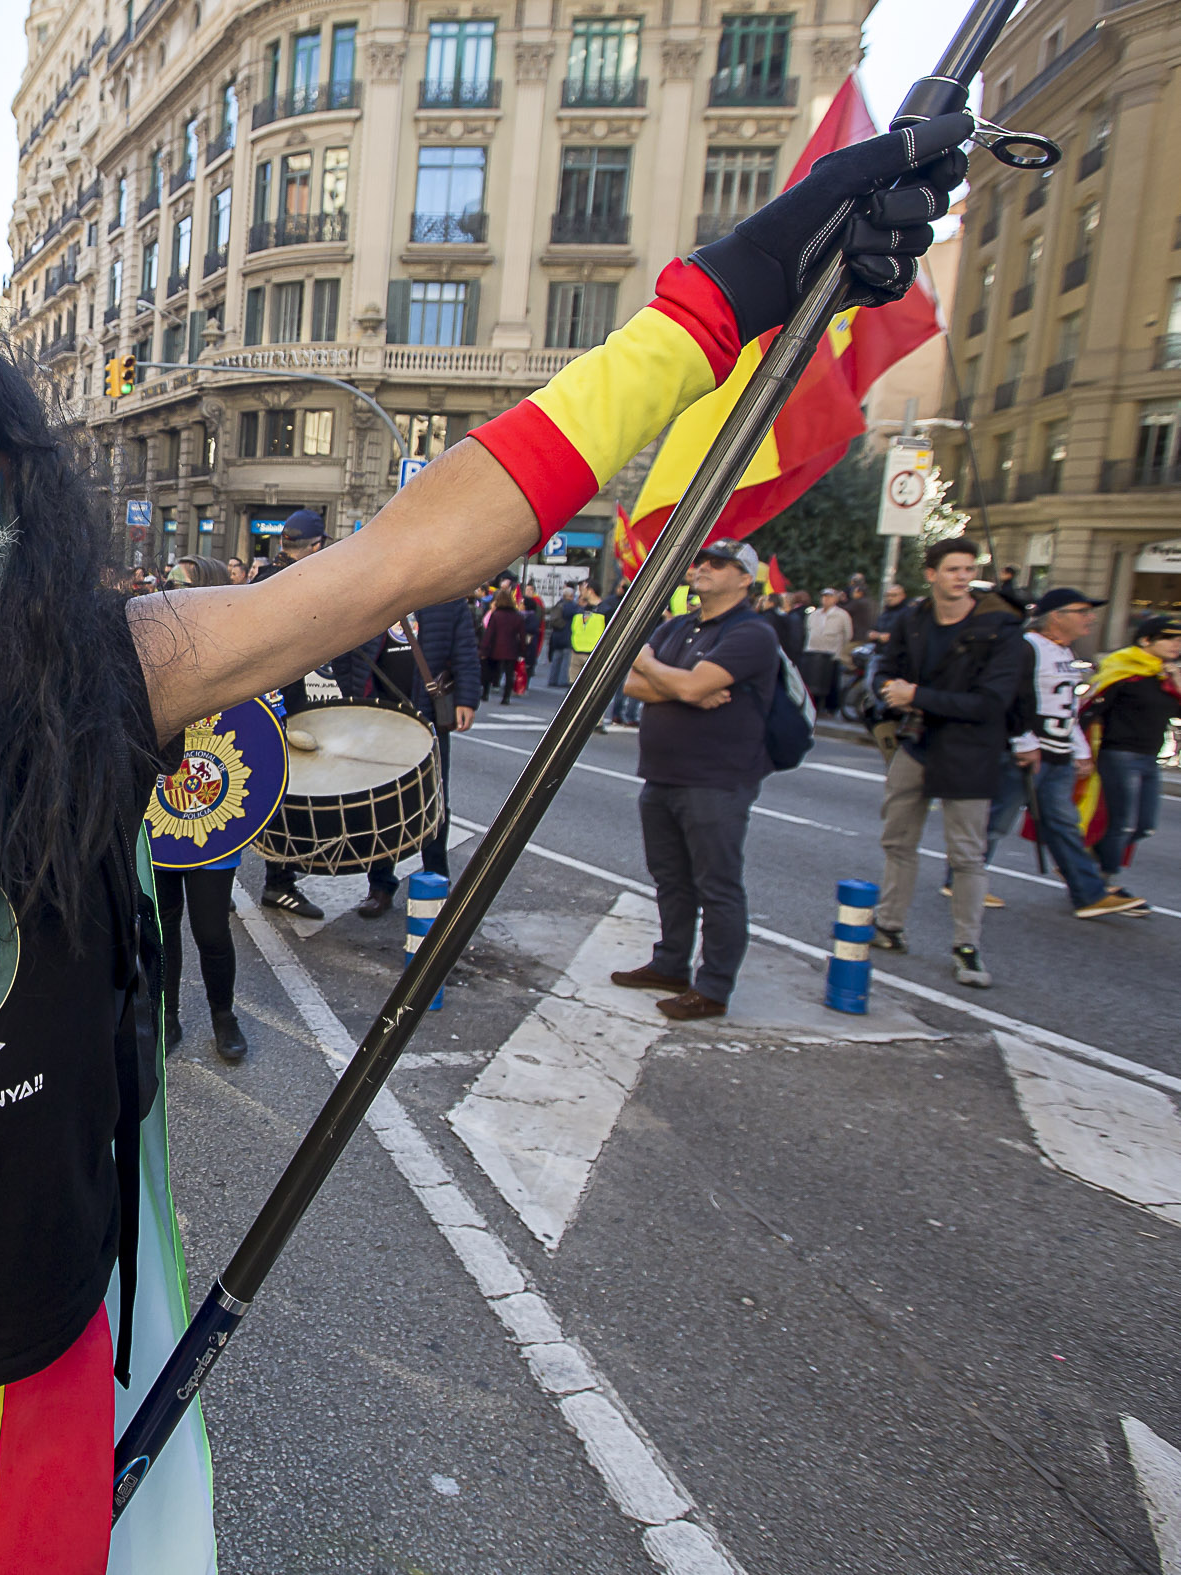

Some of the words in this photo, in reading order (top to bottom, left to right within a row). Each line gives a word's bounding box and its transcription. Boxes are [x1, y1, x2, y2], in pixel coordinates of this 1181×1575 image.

[548, 536, 563, 555] P
[218, 763, 228, 774] DE
[176, 1347, 217, 1400] Caperlan
[114, 1473, 139, 1507] 420
